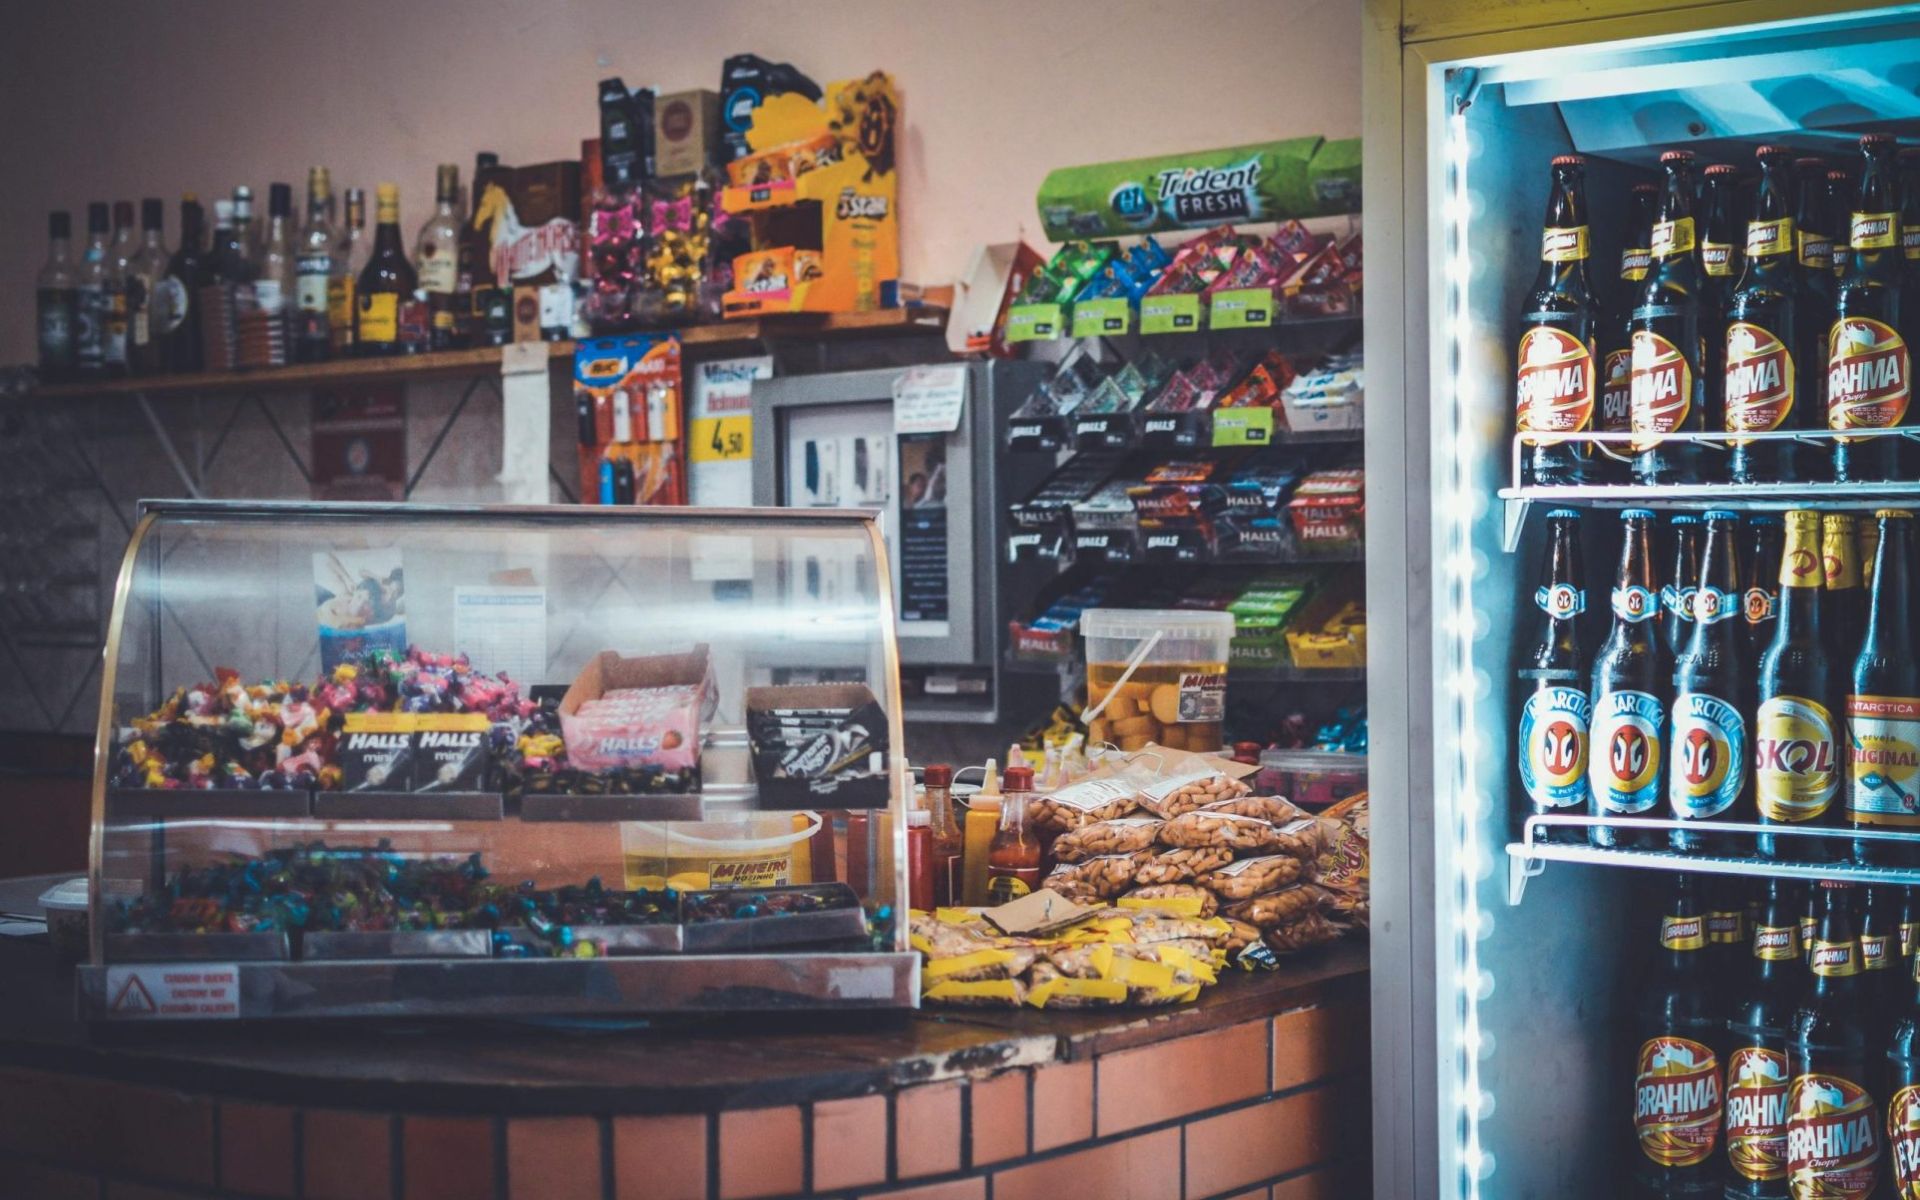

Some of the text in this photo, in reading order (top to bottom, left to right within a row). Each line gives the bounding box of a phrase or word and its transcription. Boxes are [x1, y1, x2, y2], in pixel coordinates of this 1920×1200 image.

[1159, 163, 1258, 199] Trident
[1180, 193, 1242, 214] FRESH
[712, 420, 742, 457] 4,50
[1227, 496, 1262, 506] HALLS
[1240, 531, 1280, 542] HALLS
[1303, 525, 1348, 538] HALLS
[1020, 638, 1059, 650] HALLS
[1230, 647, 1273, 658] HALLS
[349, 733, 410, 749] HALLS
[419, 731, 481, 748] HALLS
[600, 735, 660, 753] HALLS
[363, 752, 392, 763] mini
[434, 750, 464, 761] mini
[1757, 739, 1833, 776] SKOL
[712, 859, 787, 879] MINEIRO
[1667, 922, 1698, 939] BRAHMA
[1638, 1074, 1718, 1118] BRAHMA
[1658, 1114, 1688, 1123] Chopp
[1728, 1092, 1788, 1129] BRAHM
[1744, 1127, 1774, 1136] Chopp
[1788, 1115, 1873, 1165] BRAHMA
[1808, 1159, 1840, 1168] Chopp
